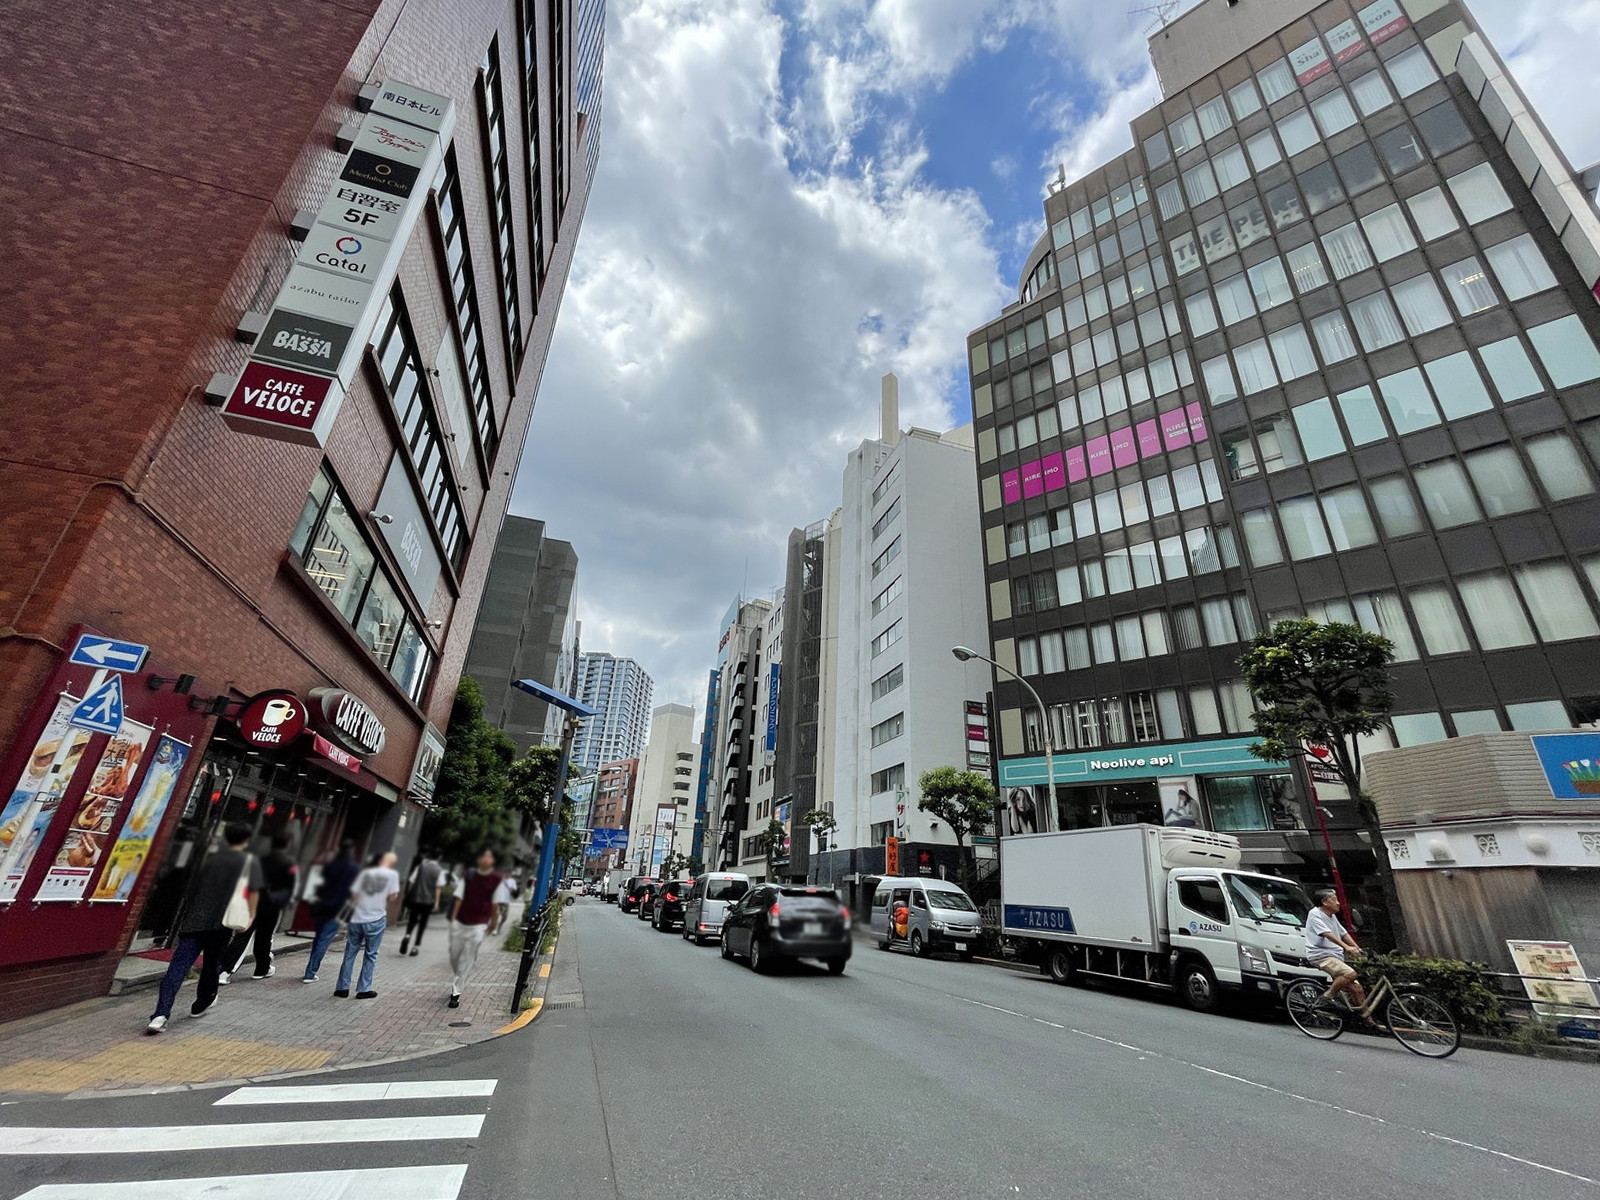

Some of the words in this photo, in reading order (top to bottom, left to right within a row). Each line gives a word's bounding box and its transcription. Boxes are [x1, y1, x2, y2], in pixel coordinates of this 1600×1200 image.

[382, 91, 441, 116] 南日本ビル
[387, 180, 408, 190] Club
[336, 187, 401, 215] 自習室
[343, 208, 379, 226] 5F
[315, 252, 367, 274] Catal
[290, 284, 325, 297] azabu
[328, 294, 360, 306] tailor
[272, 330, 332, 359] BASSA
[265, 379, 304, 396] CAFFE
[244, 386, 315, 418] VELOCE
[252, 731, 282, 743] VELOCE
[1090, 758, 1146, 771] Neolive
[1150, 754, 1174, 767] api
[896, 791, 905, 830] アザレ
[1028, 911, 1064, 928] AZASU
[1199, 924, 1222, 932] AZASU
